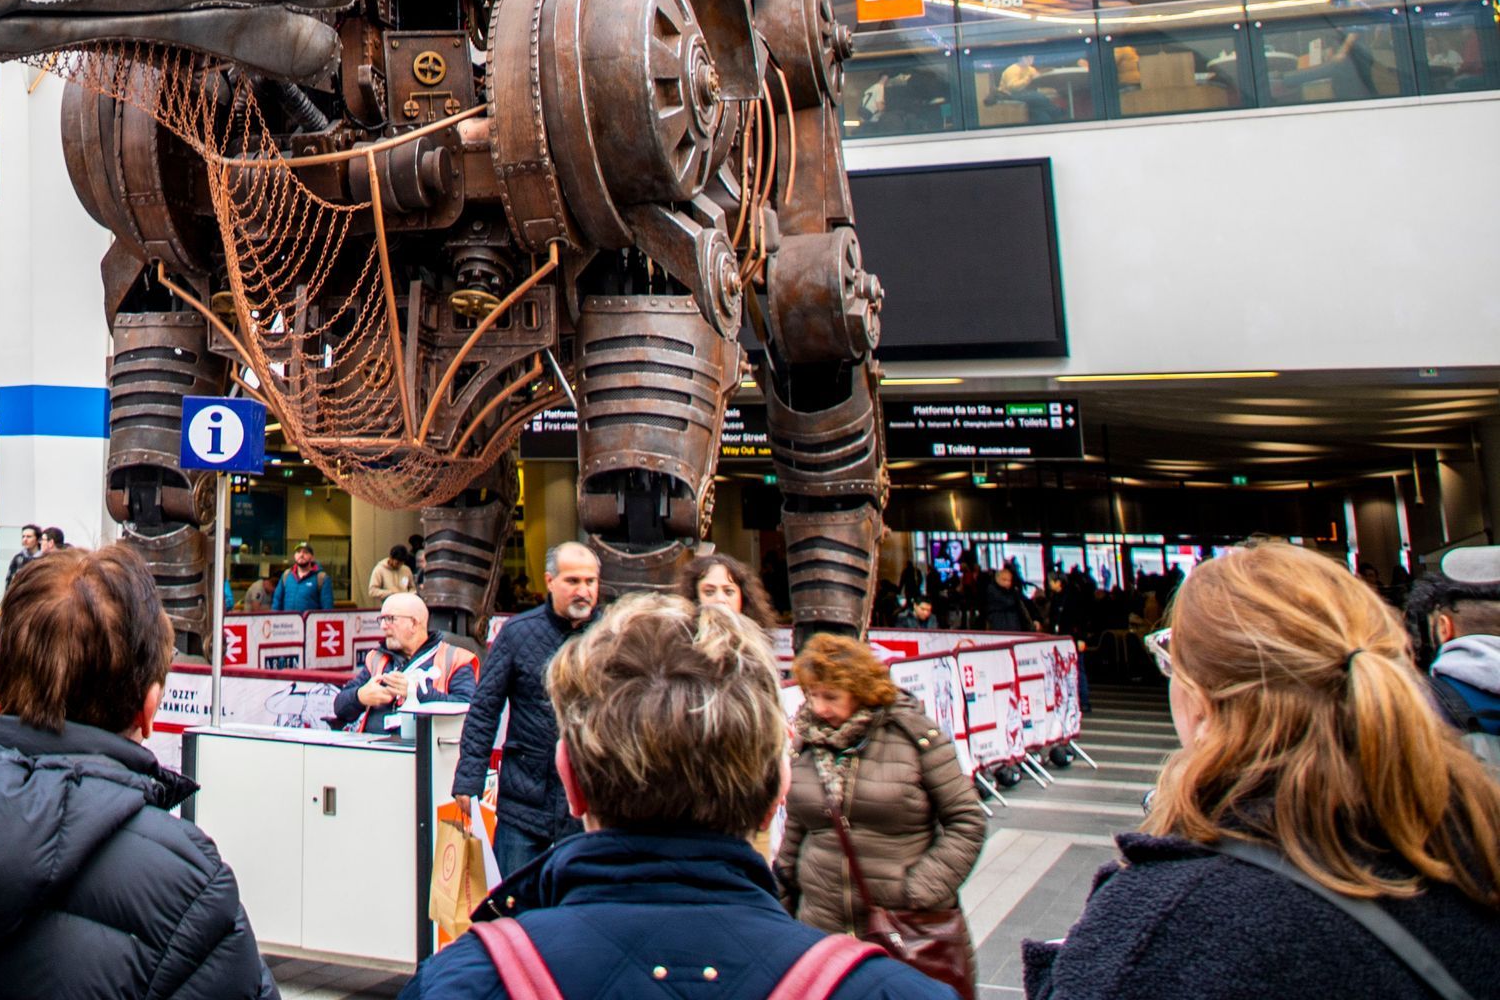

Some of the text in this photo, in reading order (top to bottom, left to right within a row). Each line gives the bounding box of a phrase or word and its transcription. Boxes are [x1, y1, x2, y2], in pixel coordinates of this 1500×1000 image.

[912, 405, 954, 416] Platforms
[967, 405, 977, 415] to
[543, 421, 561, 431] First
[1018, 417, 1048, 428] Toilets
[721, 432, 768, 442] Moor Street
[722, 446, 740, 456] Way
[740, 445, 756, 456] Out
[947, 444, 977, 456] Toilets
